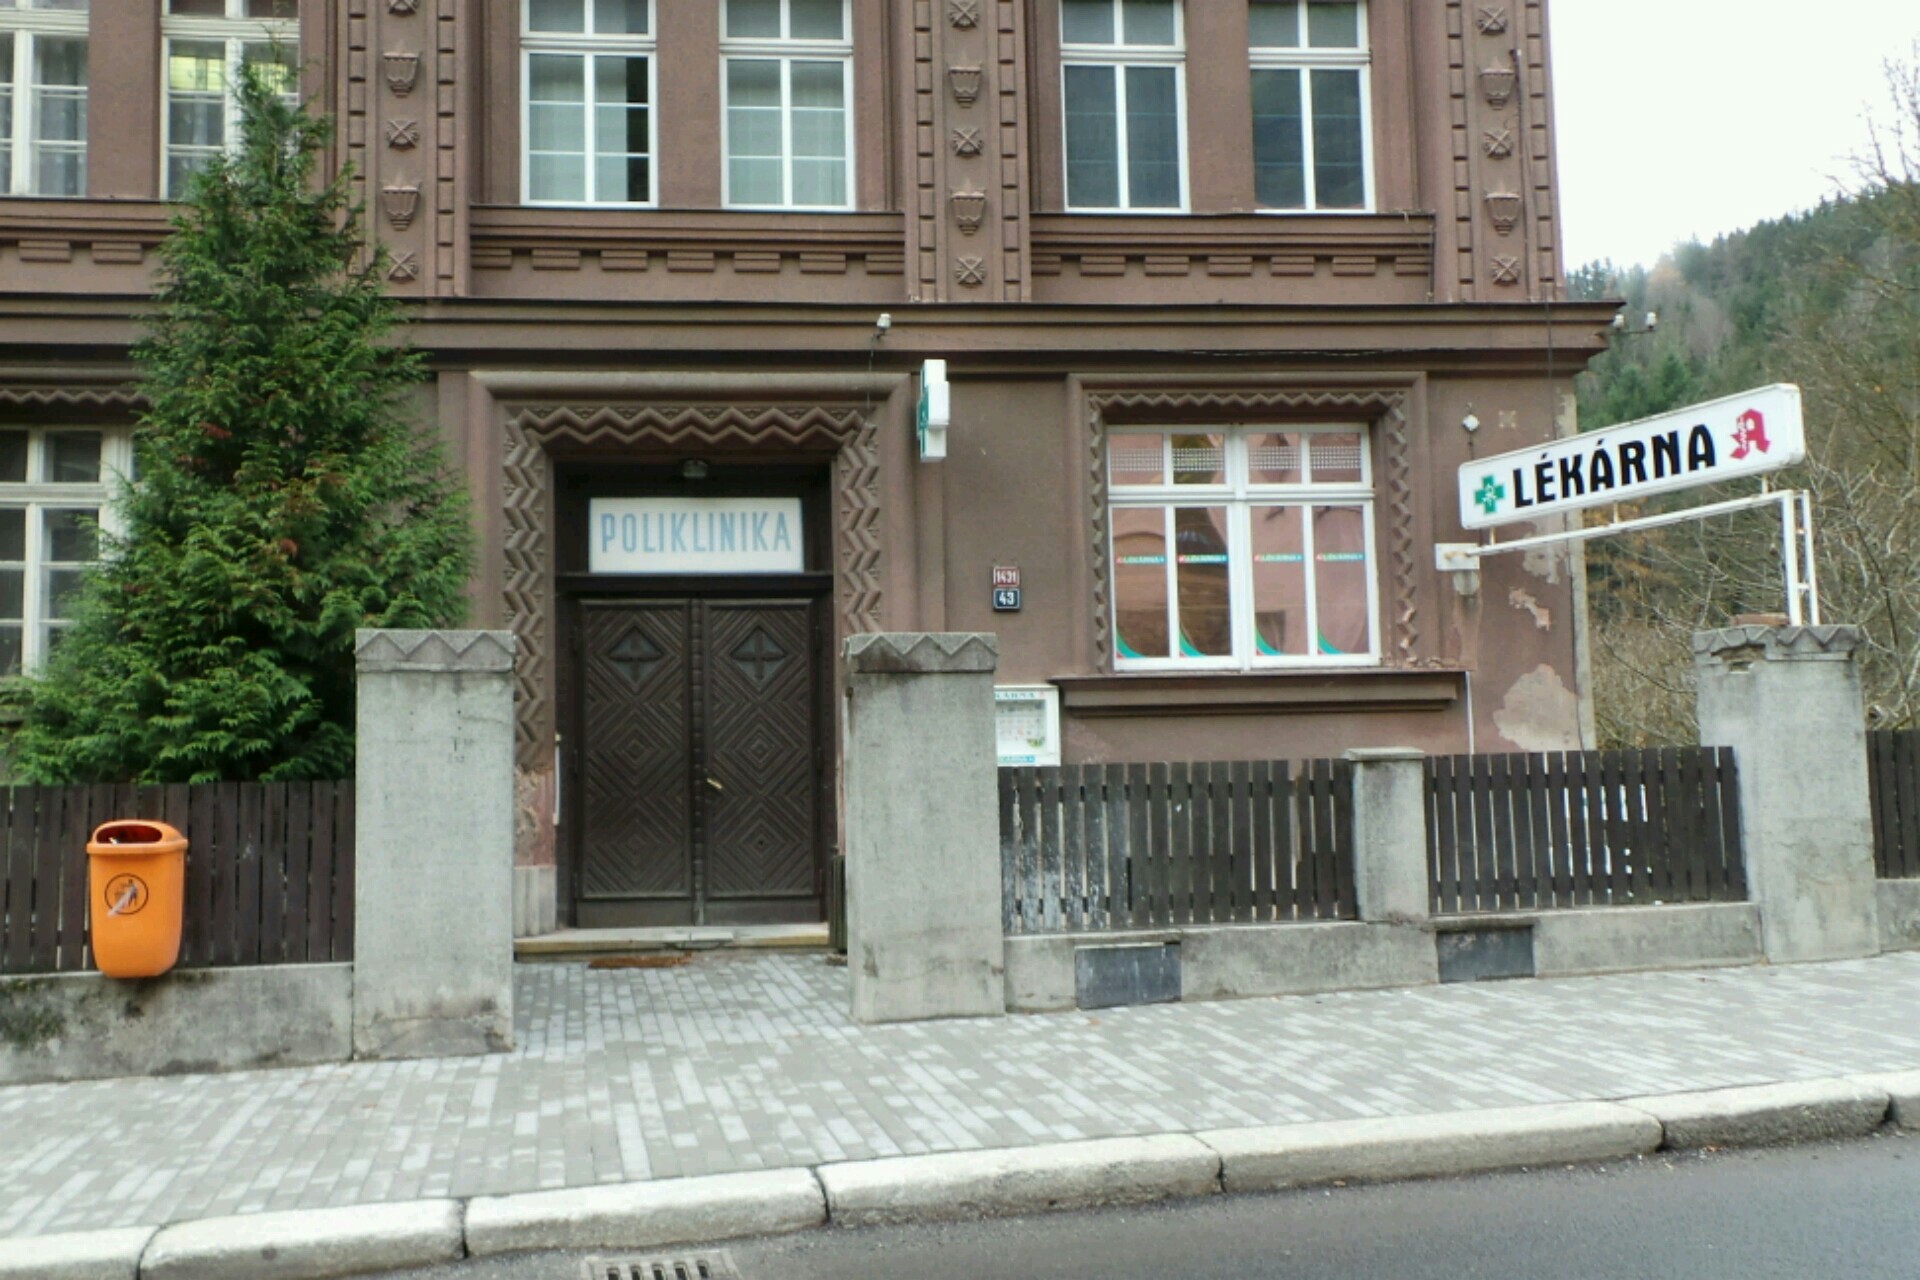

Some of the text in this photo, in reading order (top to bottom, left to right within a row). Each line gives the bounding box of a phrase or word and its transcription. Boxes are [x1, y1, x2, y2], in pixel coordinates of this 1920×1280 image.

[1512, 423, 1716, 508] LÉKÁRNA
[601, 511, 791, 553] POLIKLINIKA
[999, 591, 1015, 605] 43
